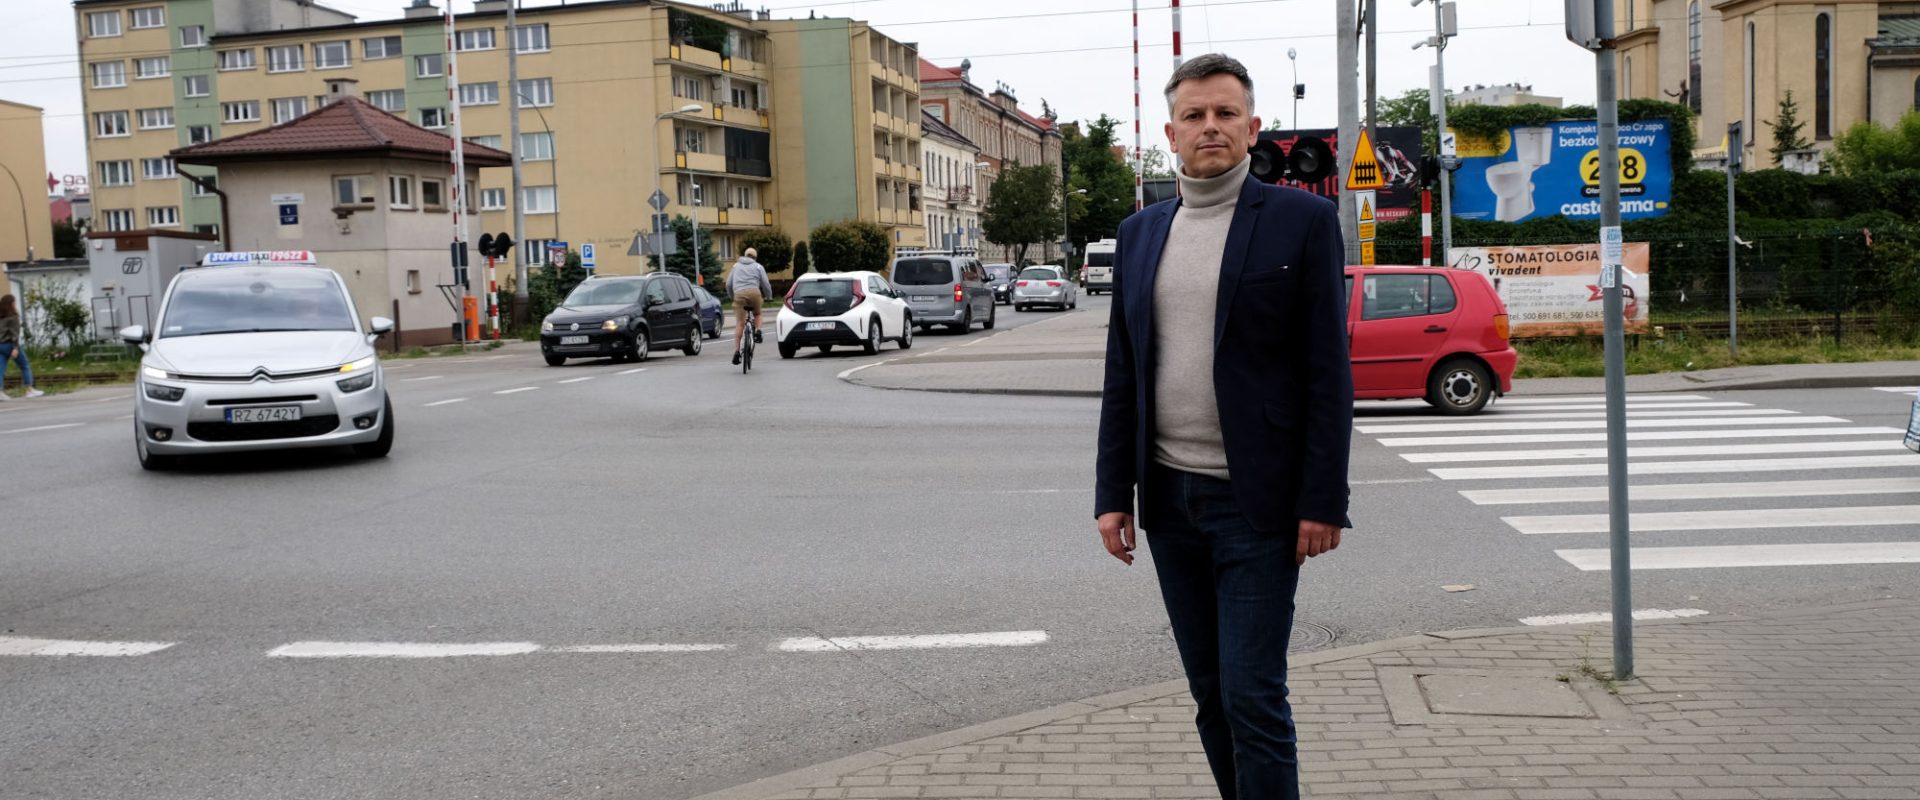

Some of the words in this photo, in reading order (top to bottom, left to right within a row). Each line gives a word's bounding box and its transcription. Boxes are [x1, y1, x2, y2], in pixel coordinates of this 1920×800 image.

[1560, 125, 1597, 135] Kompakt
[1588, 156, 1638, 180] 28
[211, 251, 248, 262] SUPER
[250, 252, 270, 262] TAXI
[1487, 250, 1600, 265] STOMATOLOGIA
[1488, 265, 1542, 276] vivadent
[234, 409, 252, 422] RZ
[257, 407, 297, 421] 6742Y
